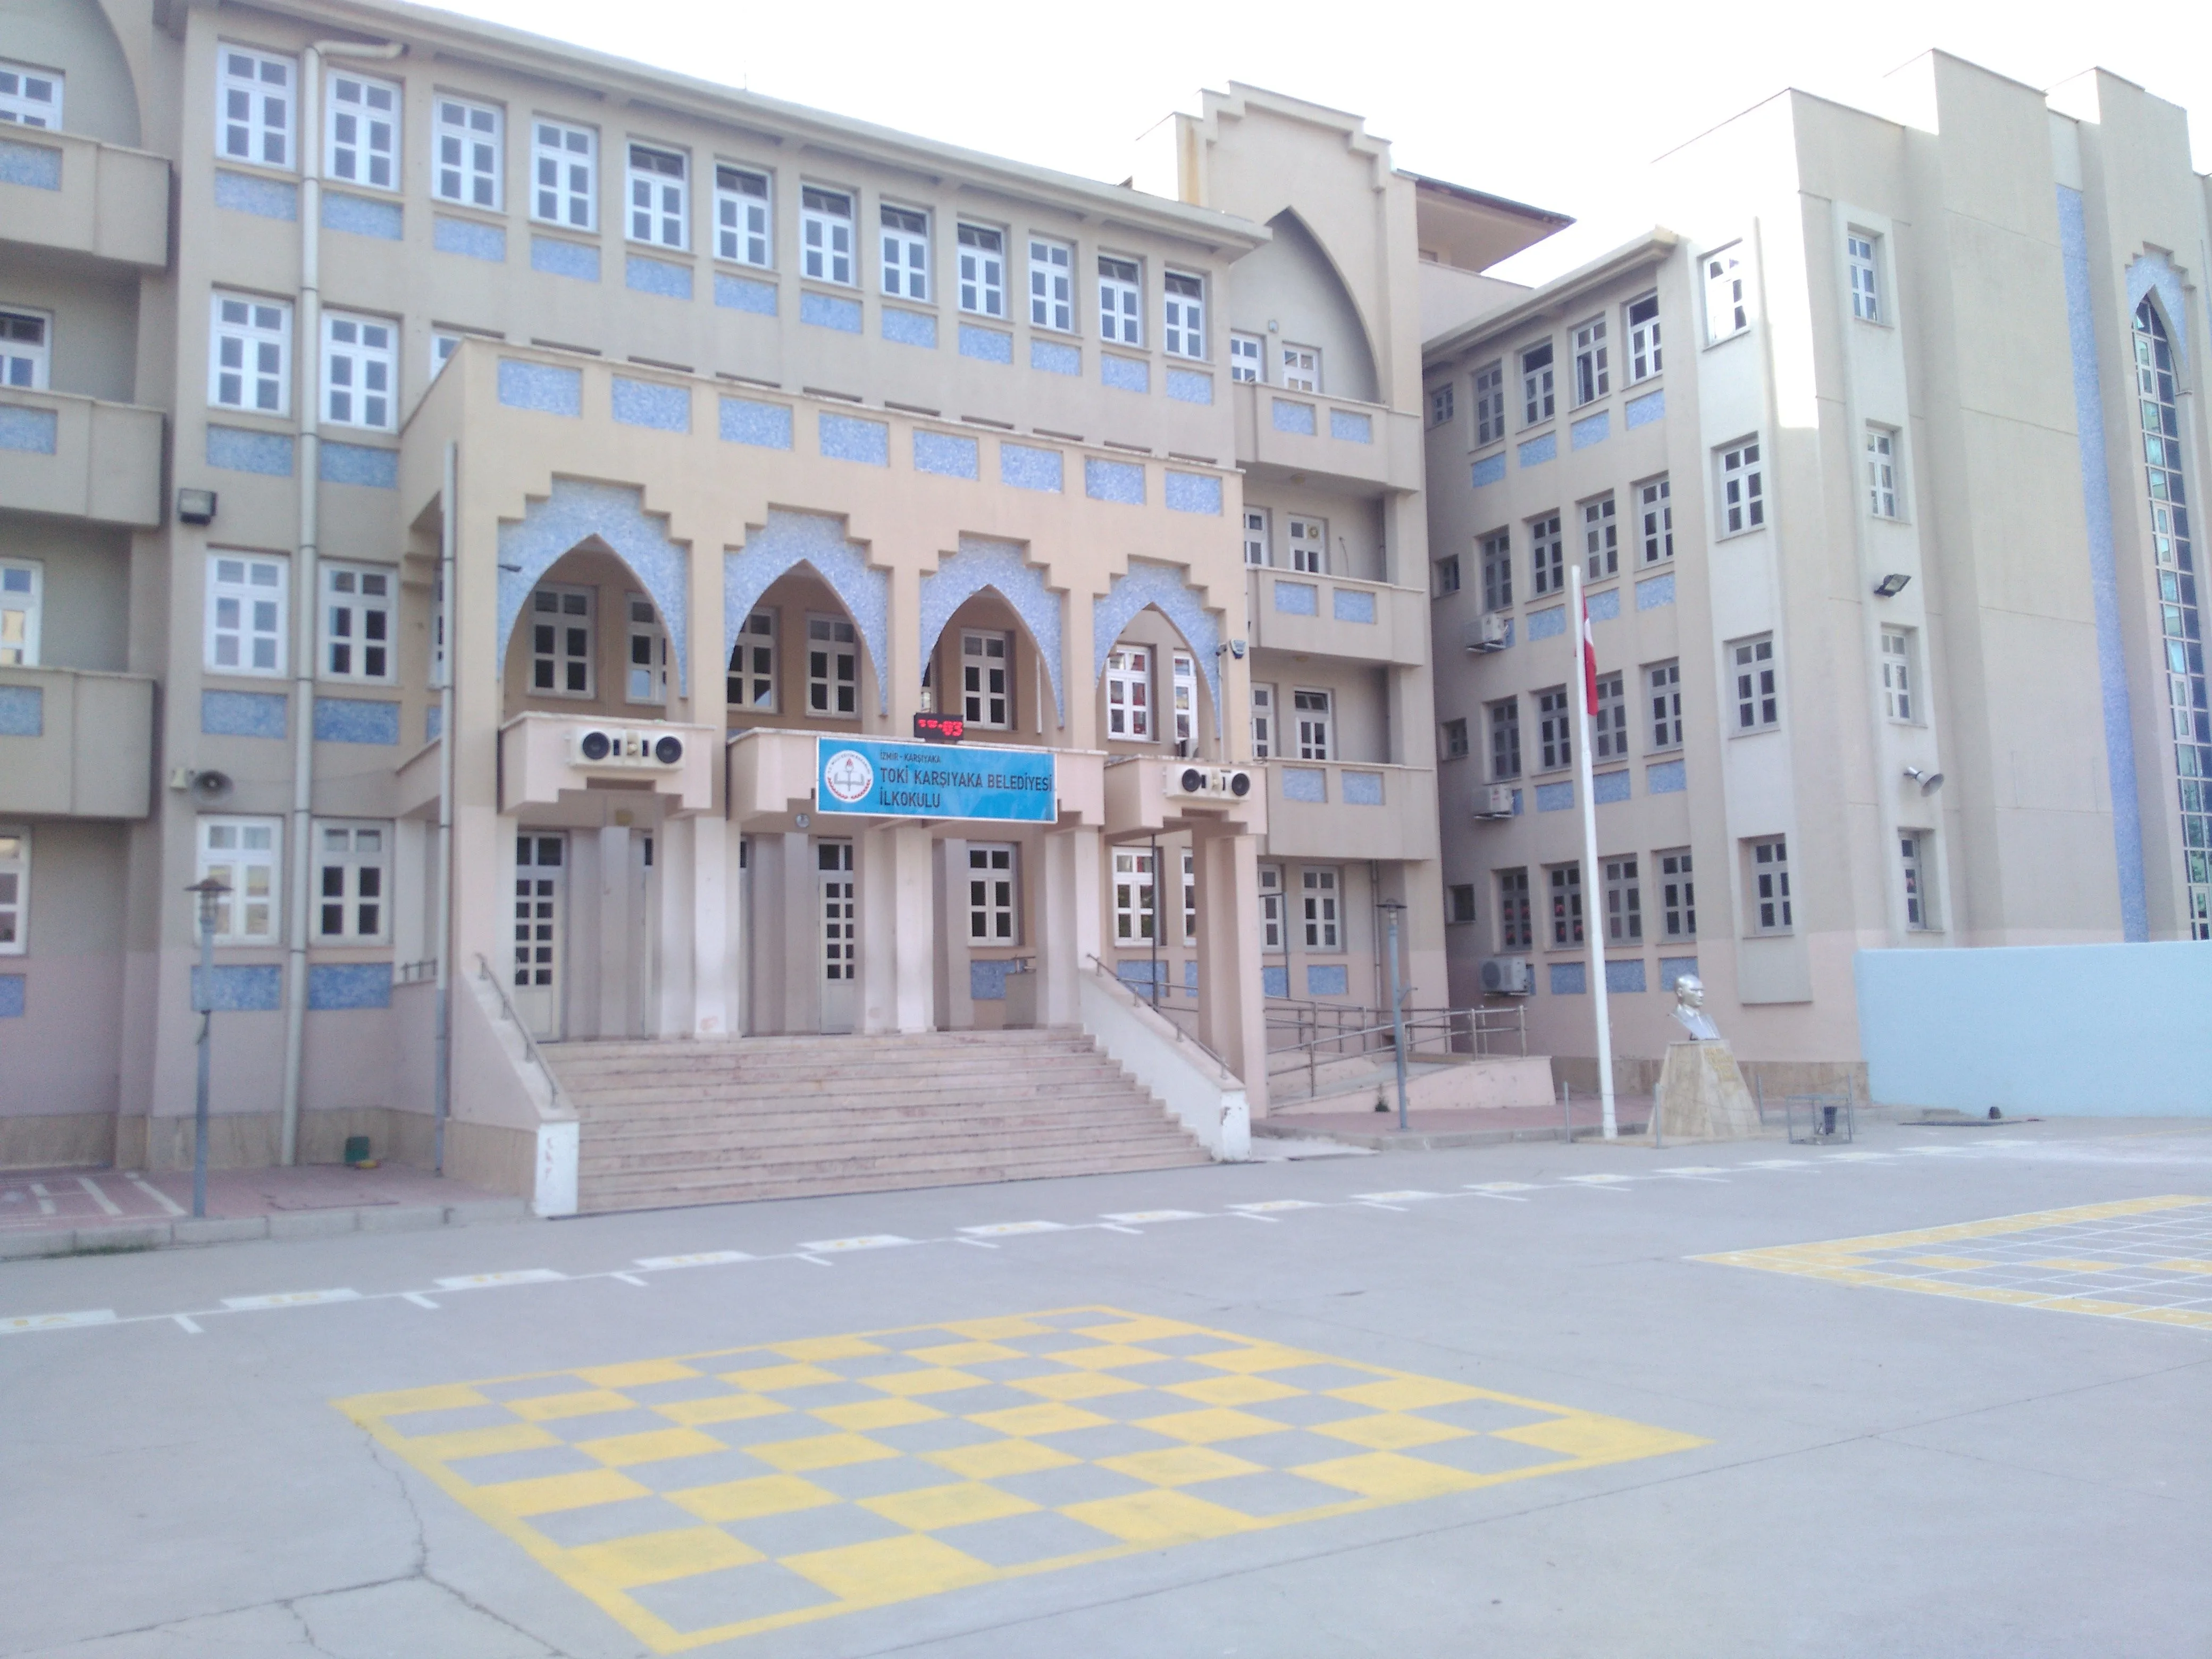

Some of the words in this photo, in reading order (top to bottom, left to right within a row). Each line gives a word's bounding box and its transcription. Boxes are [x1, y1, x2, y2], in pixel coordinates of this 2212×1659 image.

[904, 753, 941, 763] KARŞIYAKA
[881, 765, 908, 783] TOKİ
[914, 769, 983, 788] KARŞIYAKA
[987, 772, 1052, 791] BELEDİYESİ
[880, 786, 941, 808] İLKOKULU
